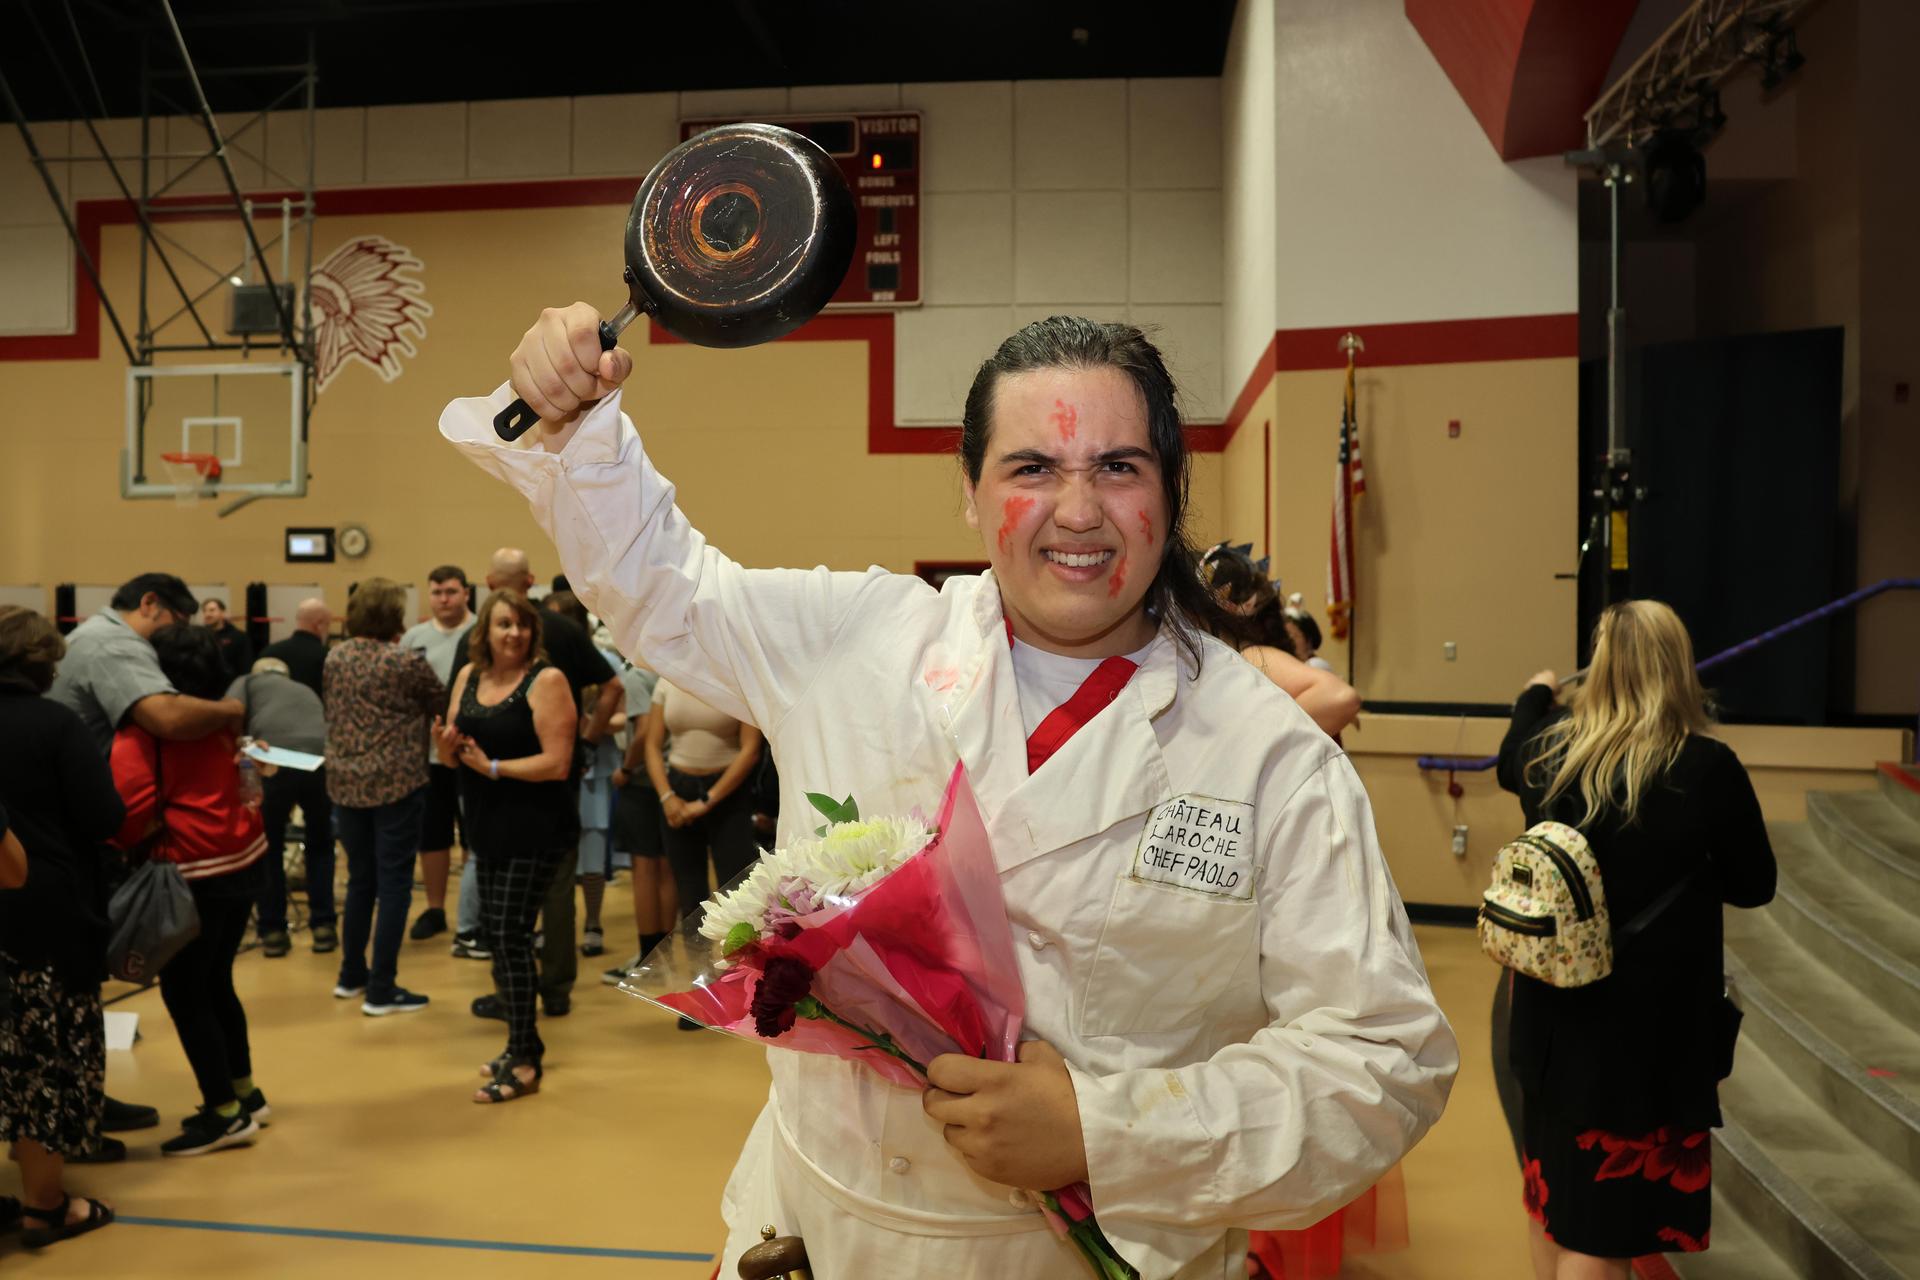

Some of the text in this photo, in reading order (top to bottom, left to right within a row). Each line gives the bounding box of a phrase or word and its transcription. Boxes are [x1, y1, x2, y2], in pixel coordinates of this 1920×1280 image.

[861, 118, 917, 133] VISITOR
[1157, 799, 1241, 835] CHÂTEAU
[1150, 824, 1238, 857] LAROCHE
[1143, 845, 1239, 888] CHEF PAOLO
